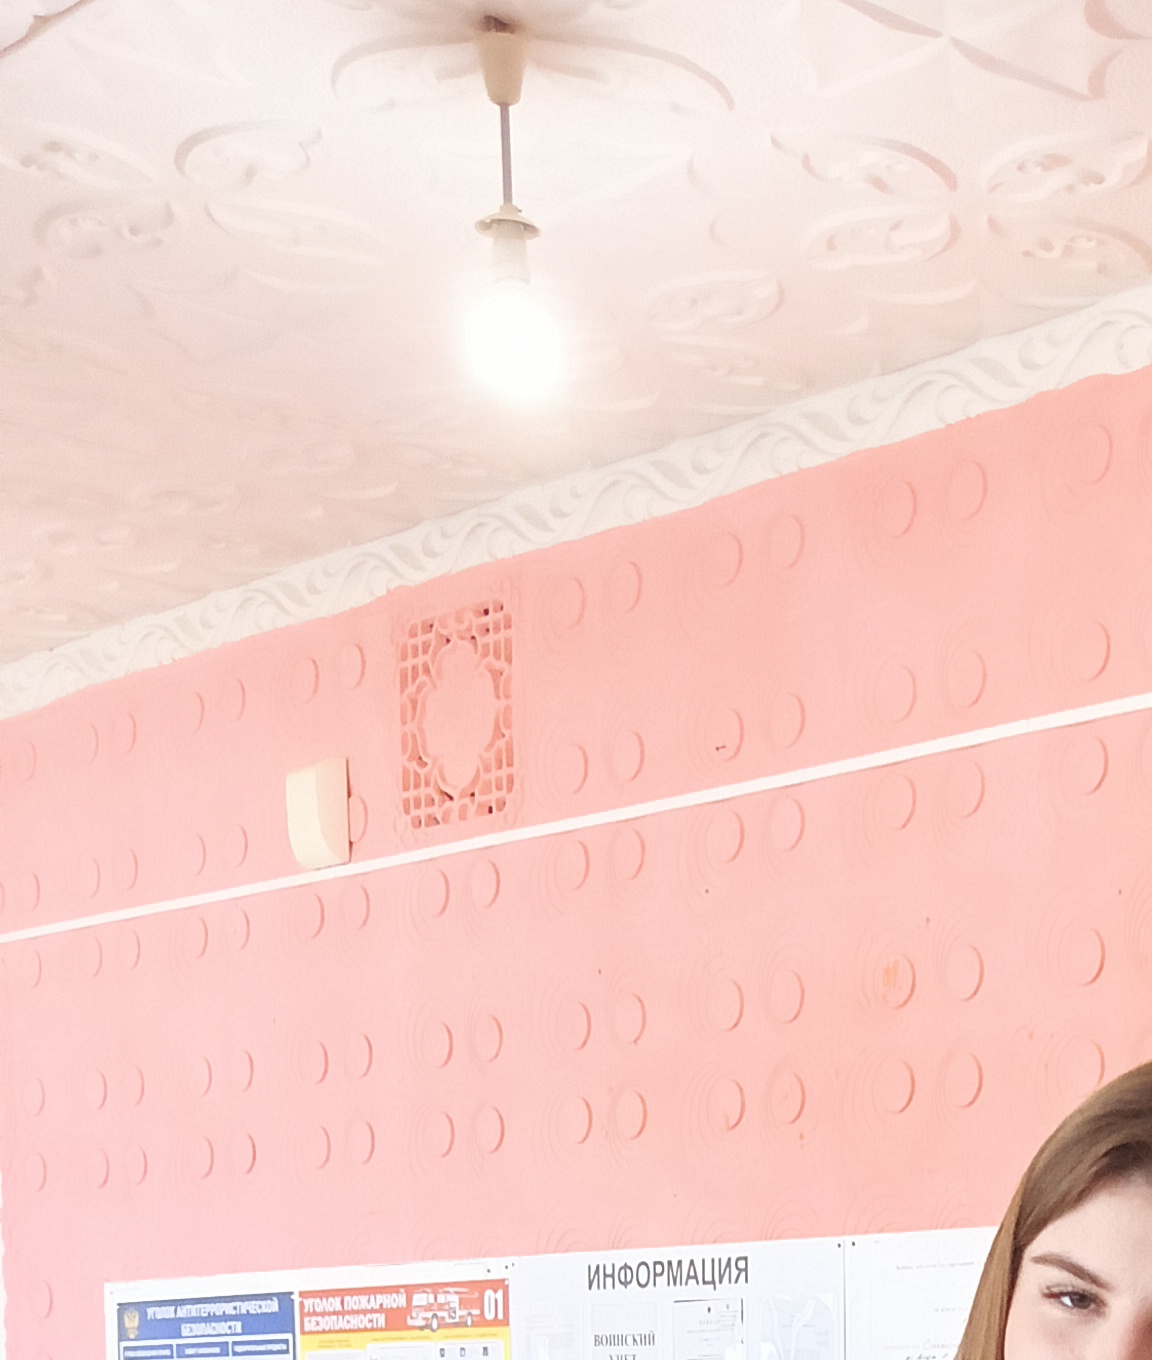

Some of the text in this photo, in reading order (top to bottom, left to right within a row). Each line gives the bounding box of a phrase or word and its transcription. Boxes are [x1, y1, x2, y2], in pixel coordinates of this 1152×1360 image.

[588, 1256, 749, 1291] ИНФОРМАЦИЯ
[303, 1289, 407, 1313] УГОЛОК ПОЖАРНОЙ
[483, 1288, 504, 1321] 01
[303, 1313, 386, 1332] БЕЗОПАСНОСТИ
[594, 1331, 656, 1347] ВОИНСКИЙ
